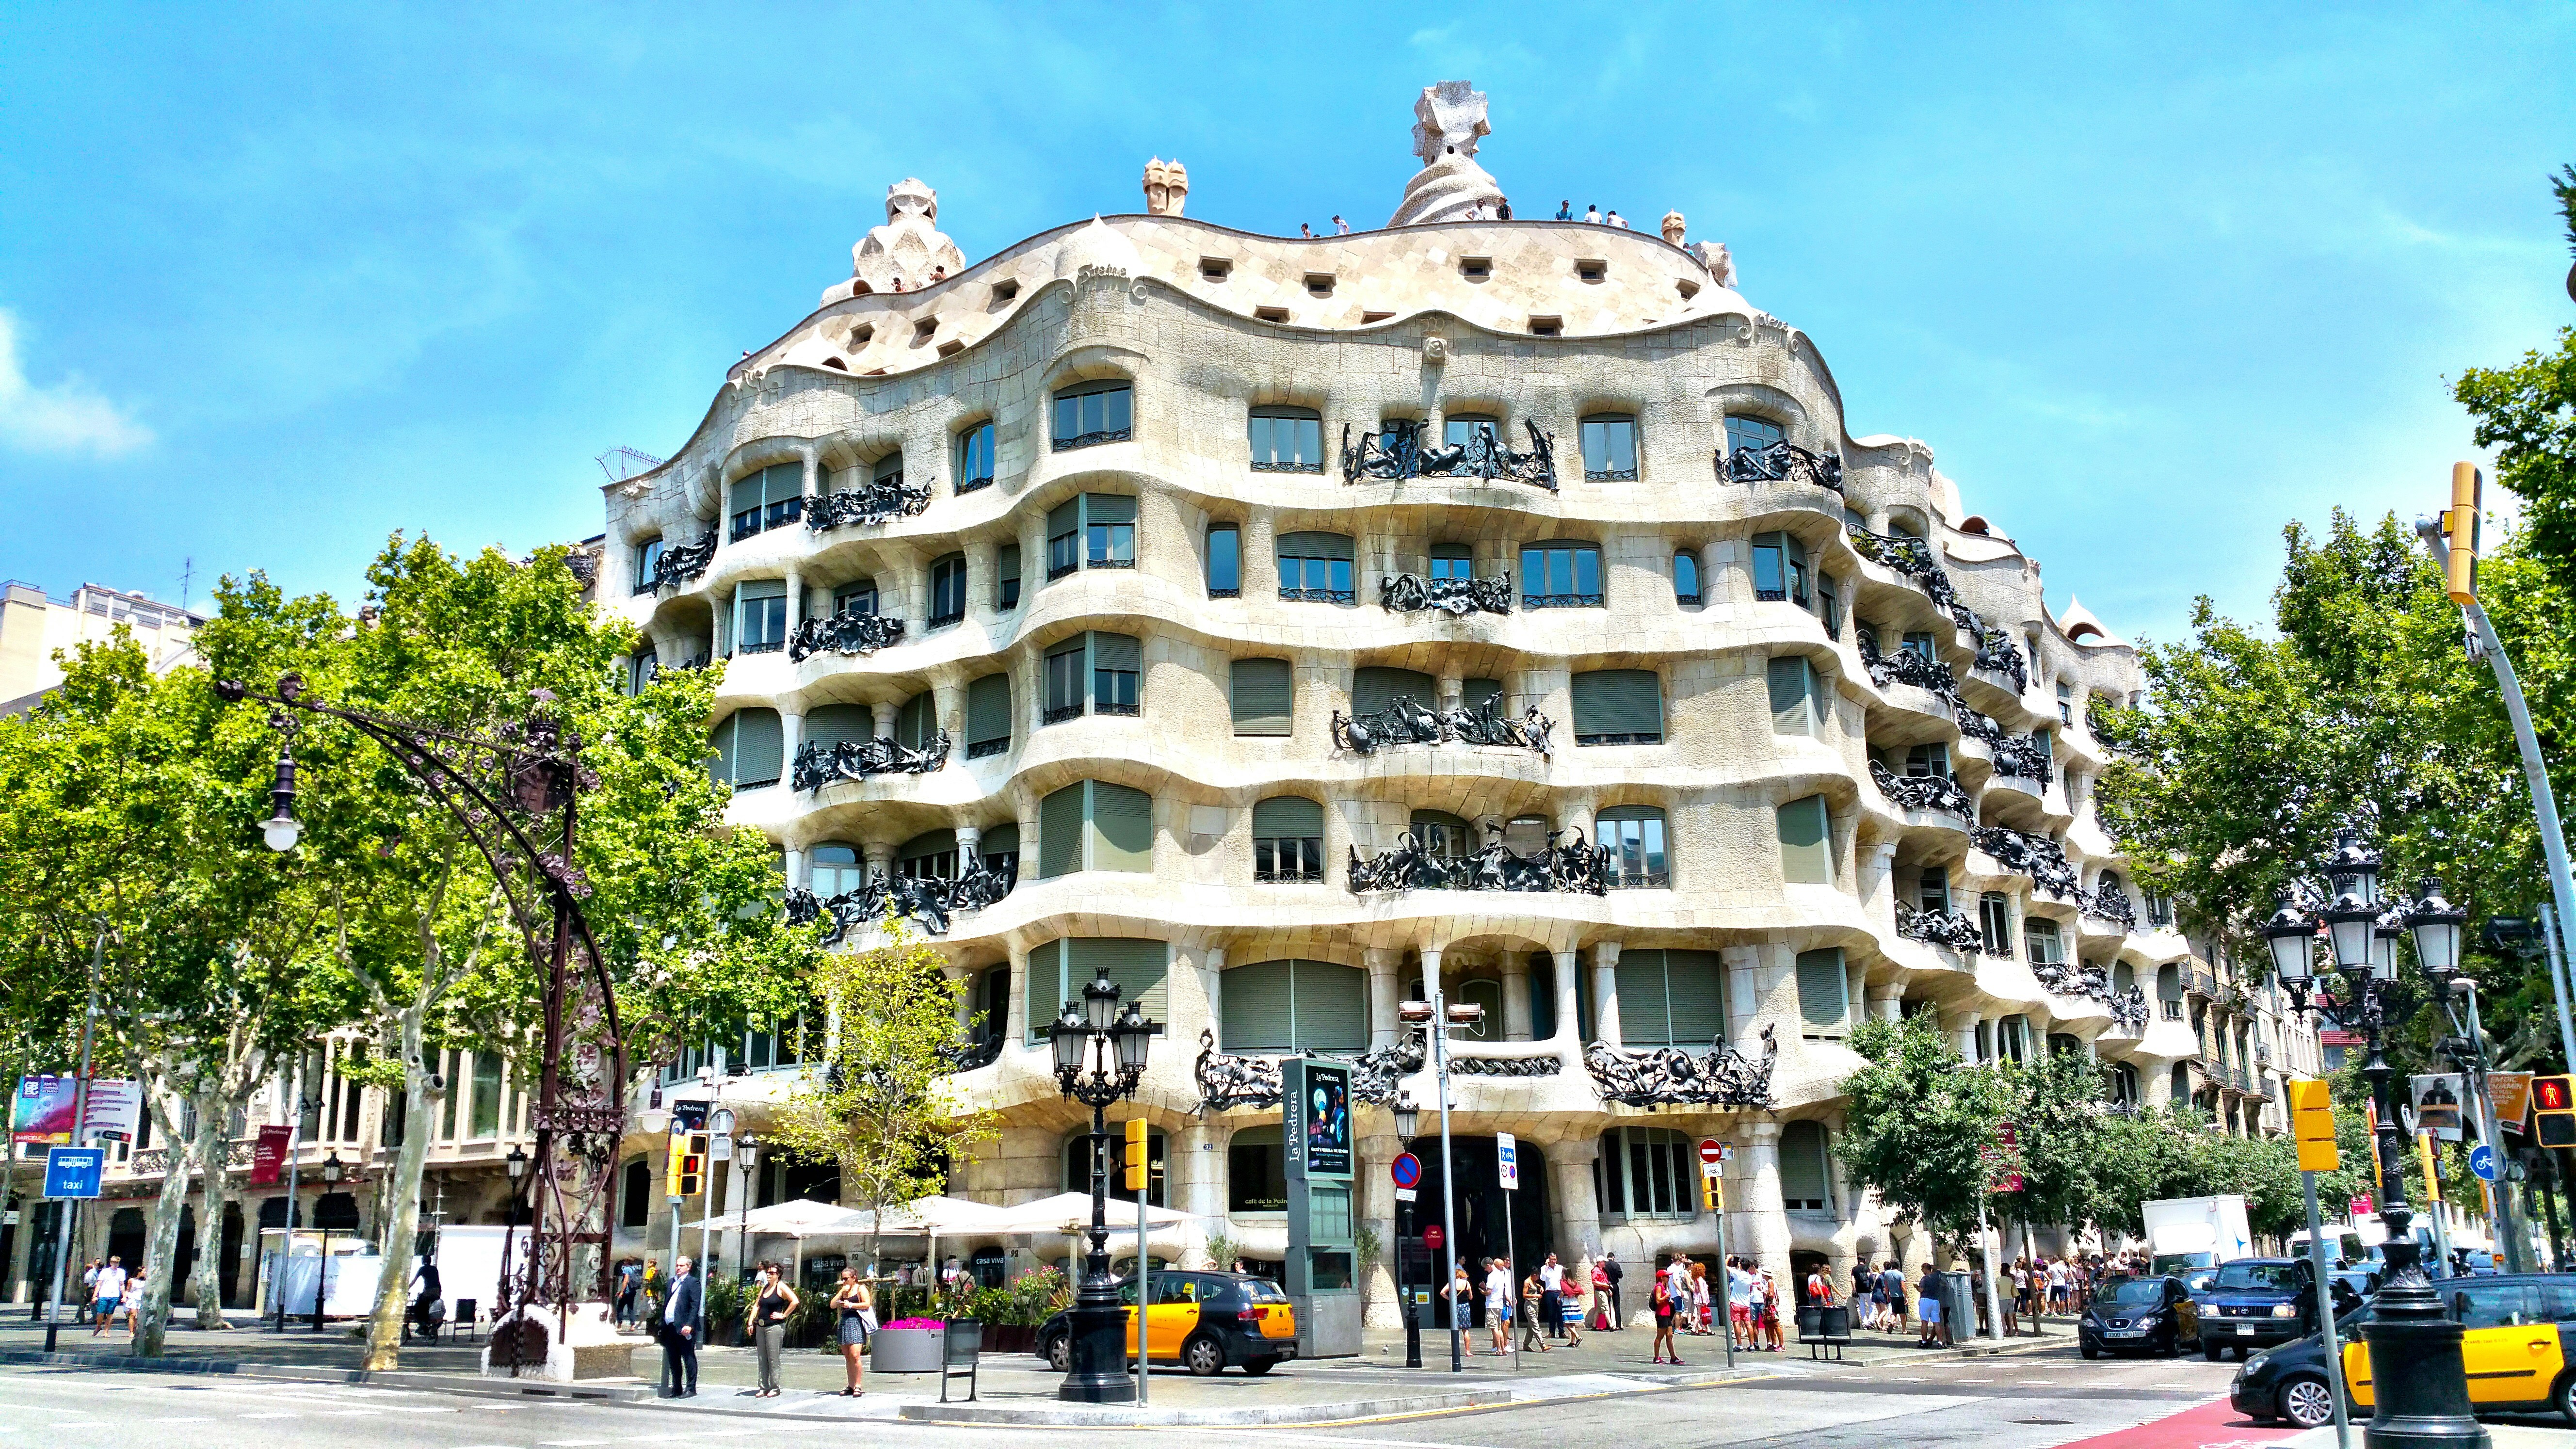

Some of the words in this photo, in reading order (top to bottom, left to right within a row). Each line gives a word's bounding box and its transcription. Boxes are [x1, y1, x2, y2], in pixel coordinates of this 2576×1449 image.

[1316, 1073, 1321, 1082] La
[1321, 1073, 1339, 1082] Pedrera
[1288, 1089, 1298, 1146] Pedrera
[1289, 1146, 1301, 1162] La
[63, 1180, 83, 1189] taxi
